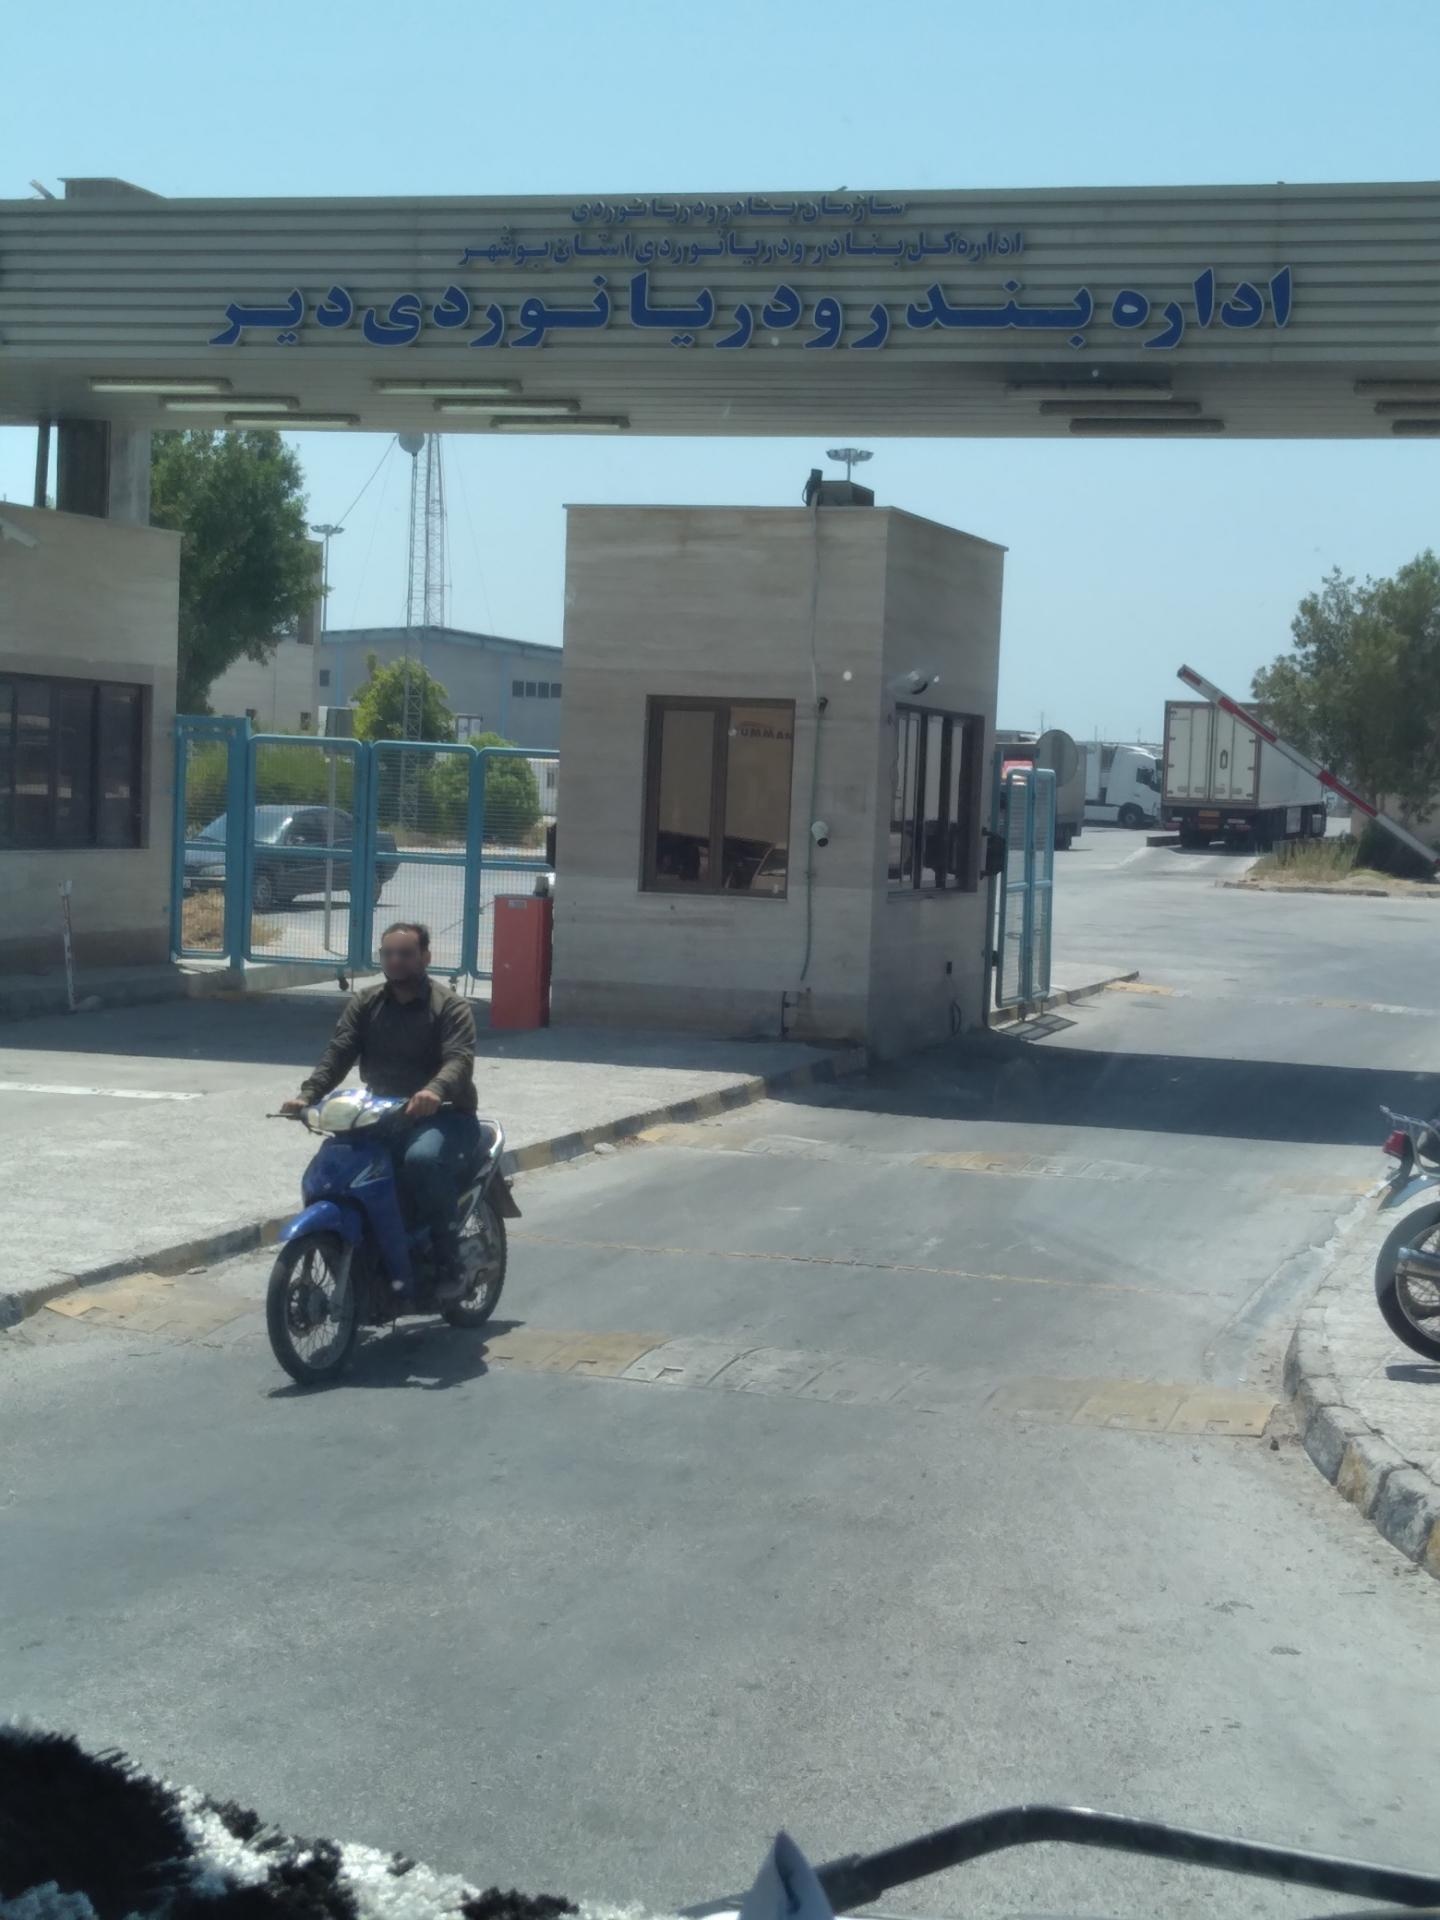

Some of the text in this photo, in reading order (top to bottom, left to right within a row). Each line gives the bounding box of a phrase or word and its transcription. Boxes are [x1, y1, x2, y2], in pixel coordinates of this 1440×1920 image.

[458, 225, 551, 268] بوشهر
[957, 231, 1024, 263] اداره
[208, 284, 353, 346] دیر
[848, 279, 1095, 350] بندر
[1110, 264, 1292, 350] اداره
